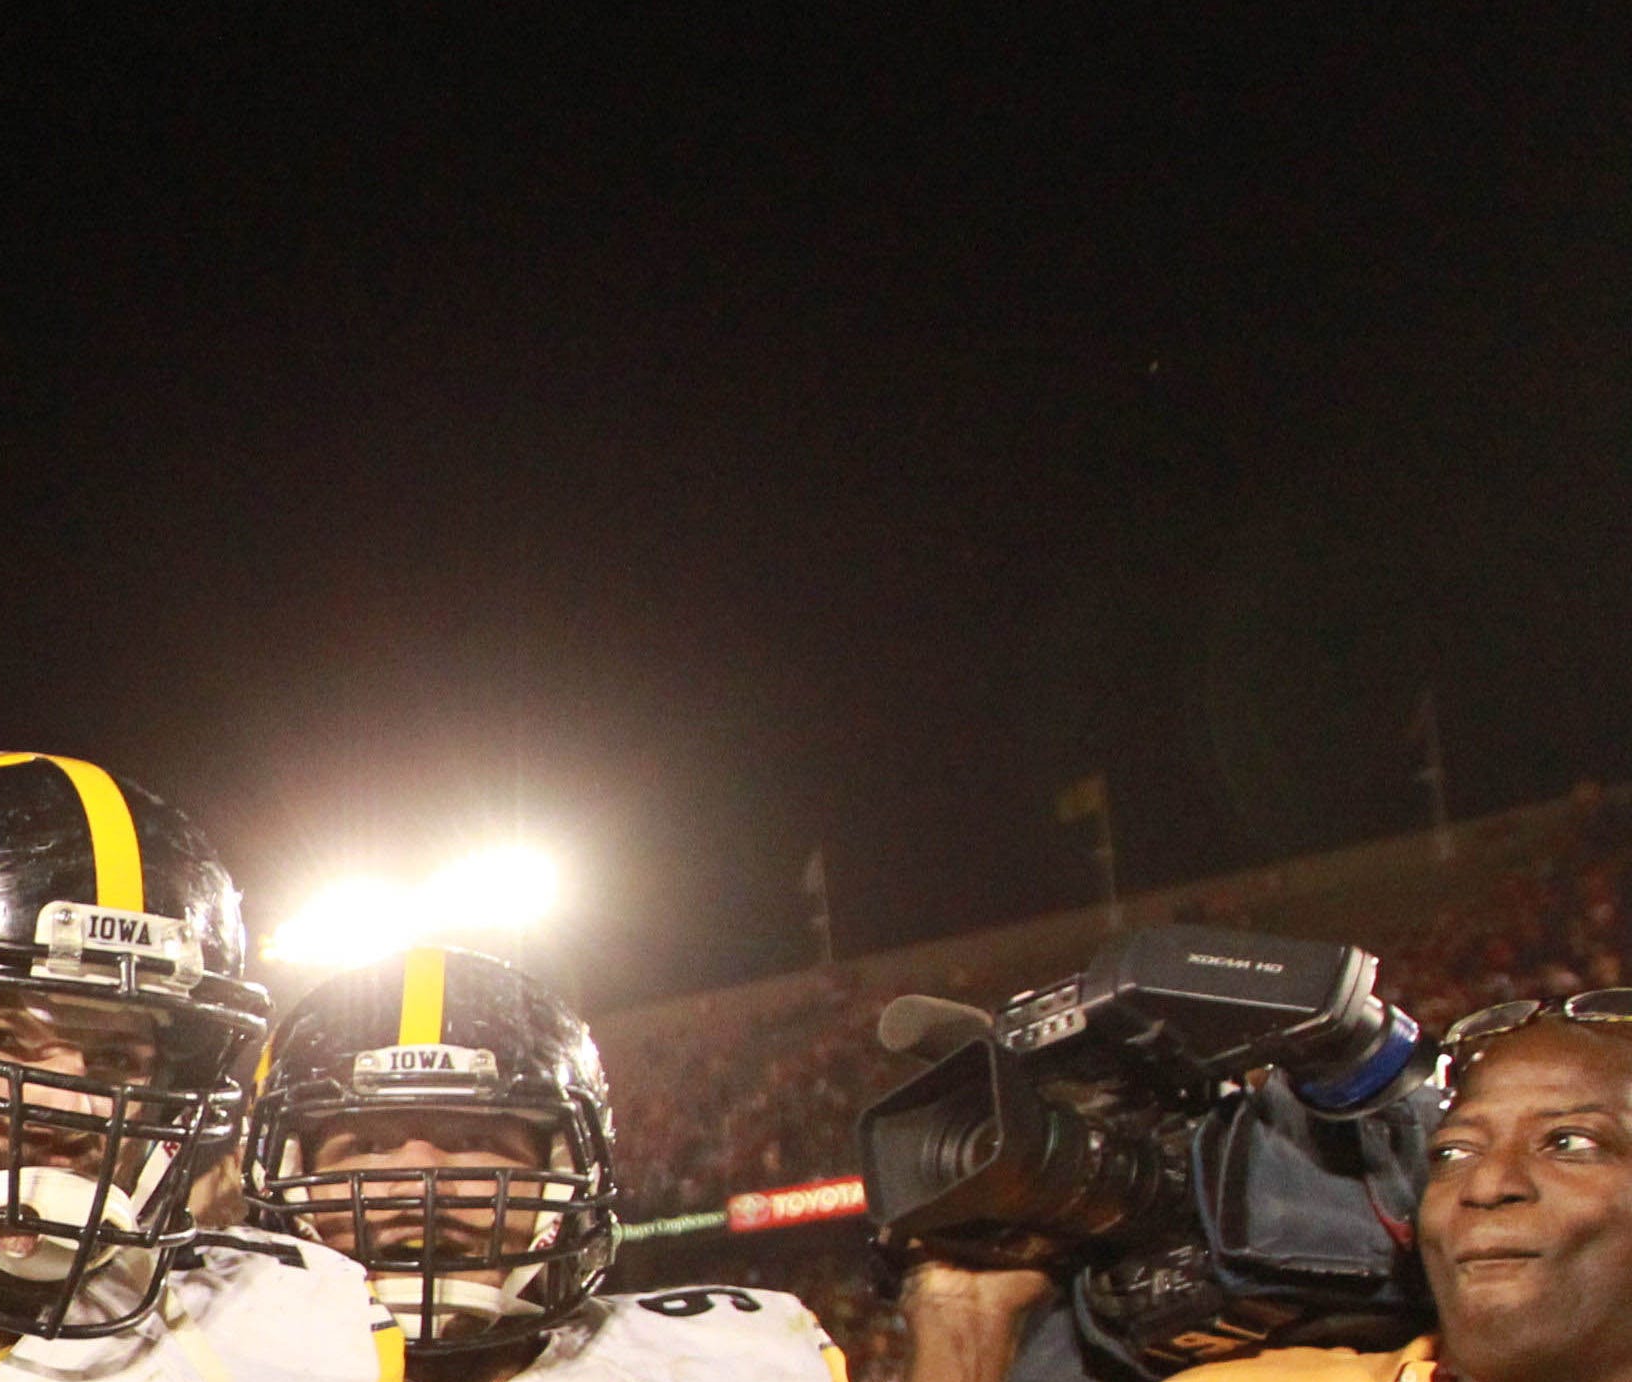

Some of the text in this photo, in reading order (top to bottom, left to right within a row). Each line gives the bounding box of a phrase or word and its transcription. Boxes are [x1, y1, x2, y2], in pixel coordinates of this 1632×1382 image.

[87, 915, 153, 947] IOWA
[389, 1049, 456, 1072] IOWA
[771, 1181, 865, 1220] TOYOTA
